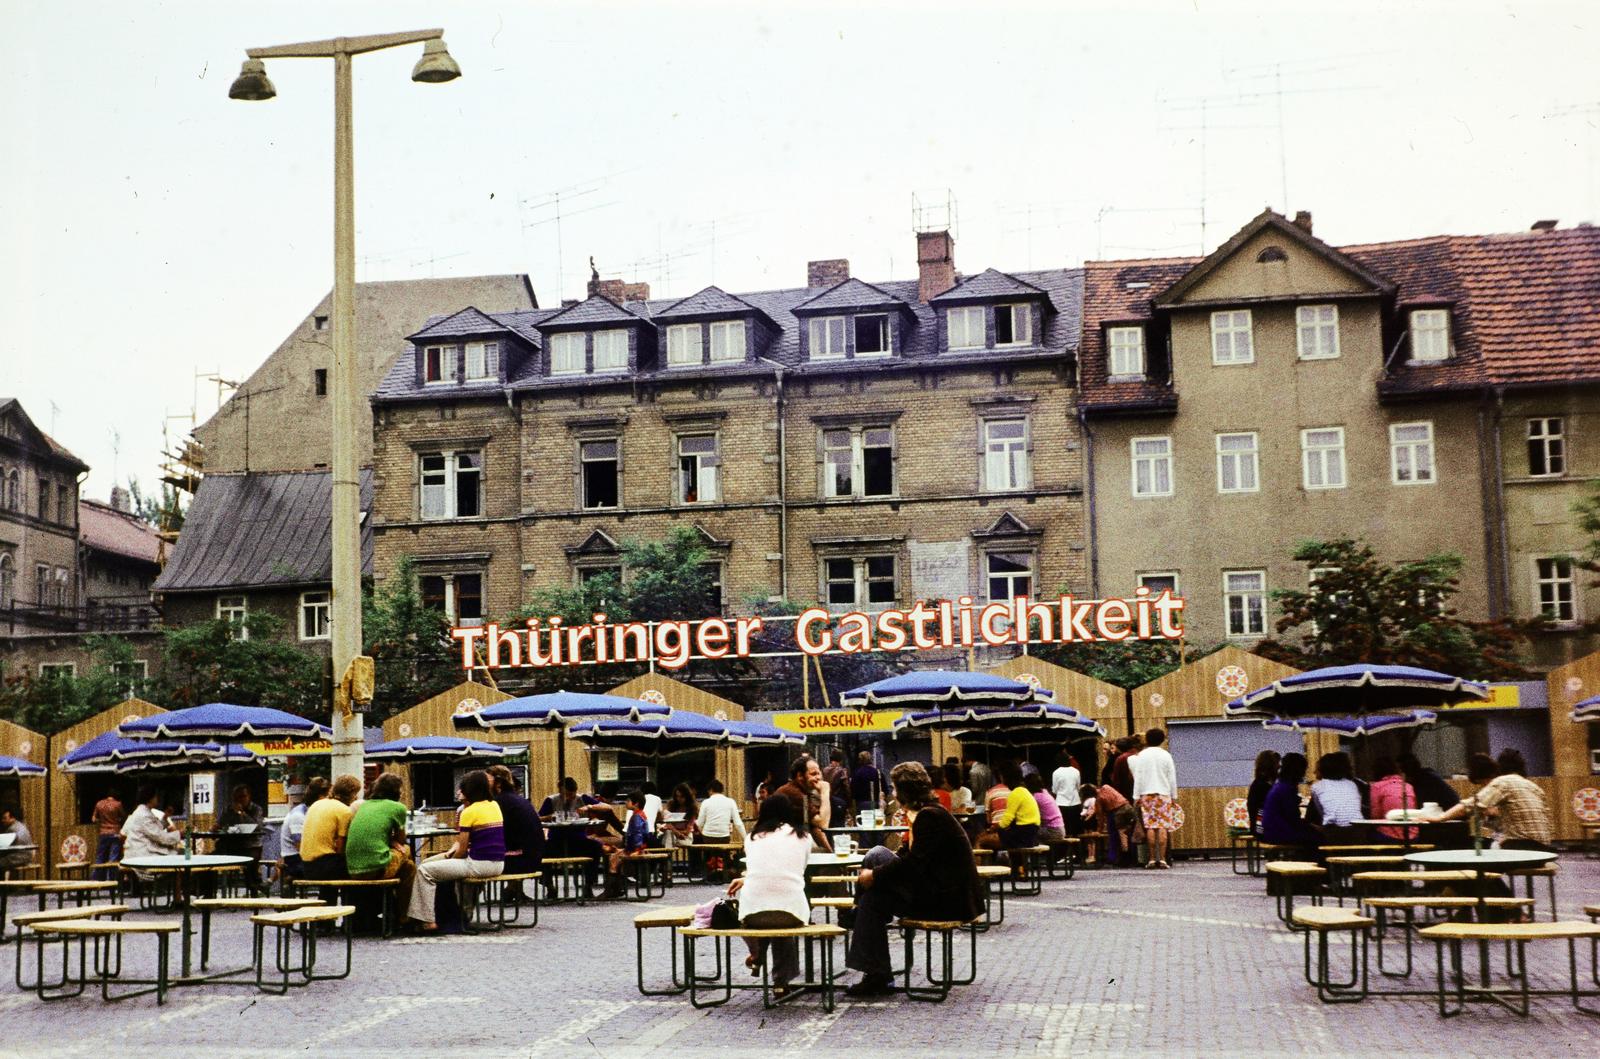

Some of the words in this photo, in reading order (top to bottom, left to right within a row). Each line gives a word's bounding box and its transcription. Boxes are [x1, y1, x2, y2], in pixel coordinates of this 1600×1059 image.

[450, 612, 761, 669] Thüringer
[795, 586, 1185, 656] Gastlichkeit
[799, 712, 874, 728] SCHASCHLYK
[193, 792, 210, 804] EIS
